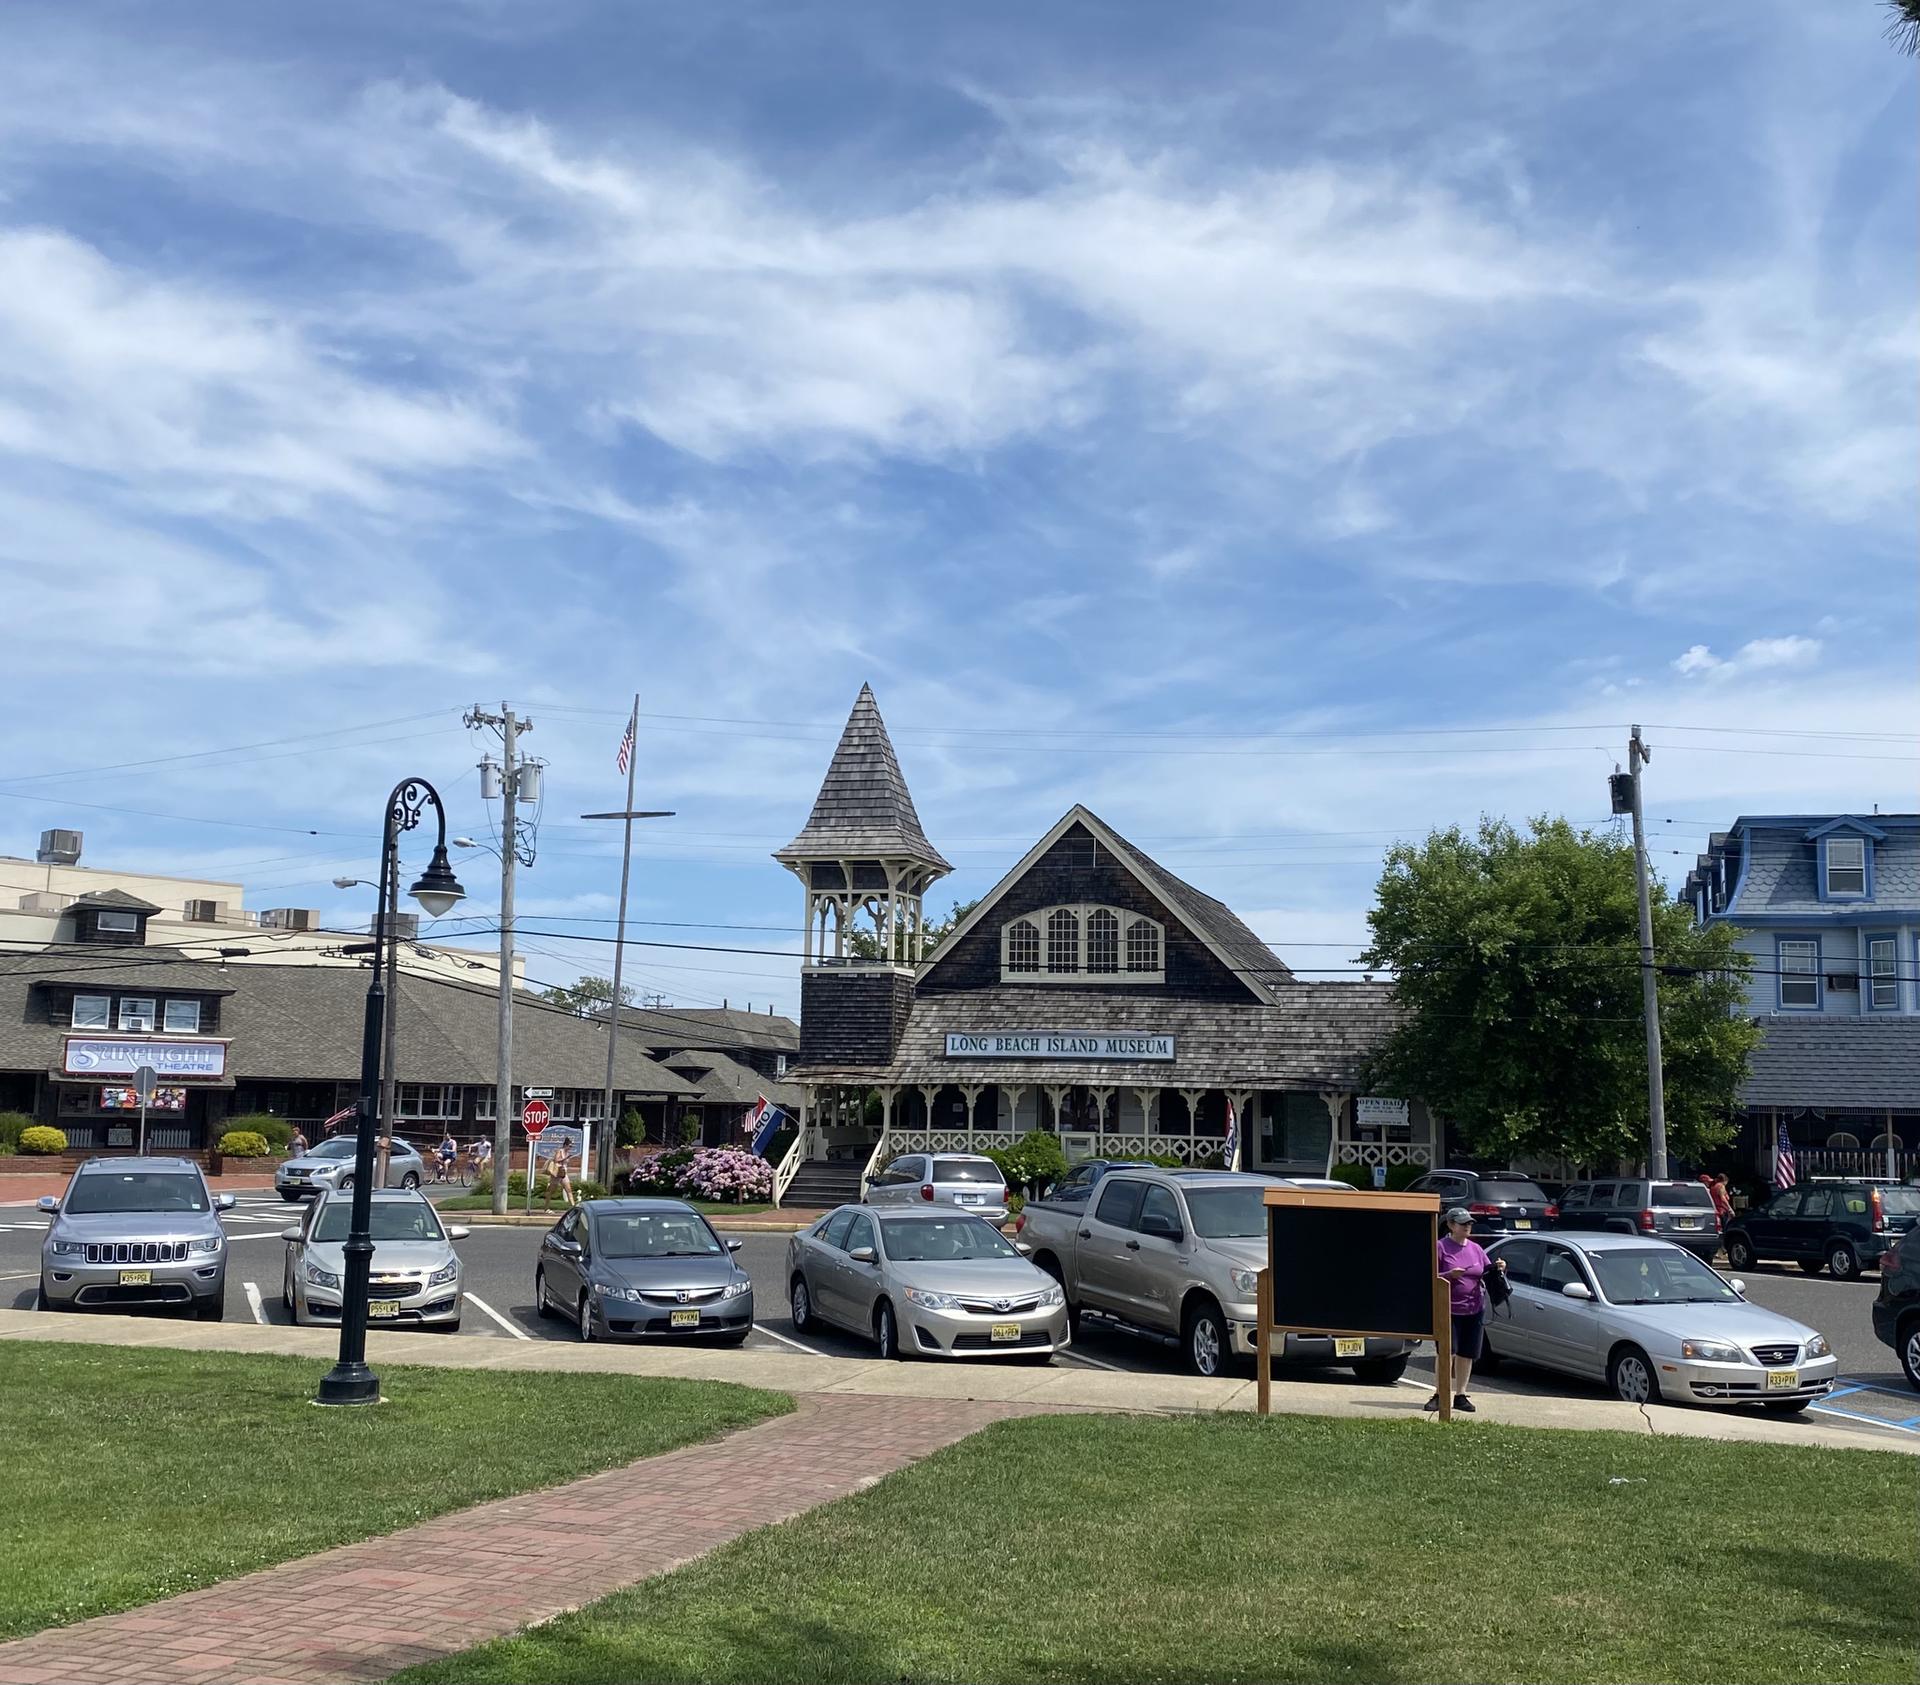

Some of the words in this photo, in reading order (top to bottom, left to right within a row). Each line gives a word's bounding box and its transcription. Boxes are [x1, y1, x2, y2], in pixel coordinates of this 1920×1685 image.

[951, 1037, 988, 1051] LONG
[996, 1038, 1039, 1052] BEACH
[1047, 1038, 1098, 1053] ISLAND
[1105, 1039, 1168, 1054] MUSEUM
[156, 1062, 214, 1071] THEATRE
[525, 1111, 548, 1124] STOP
